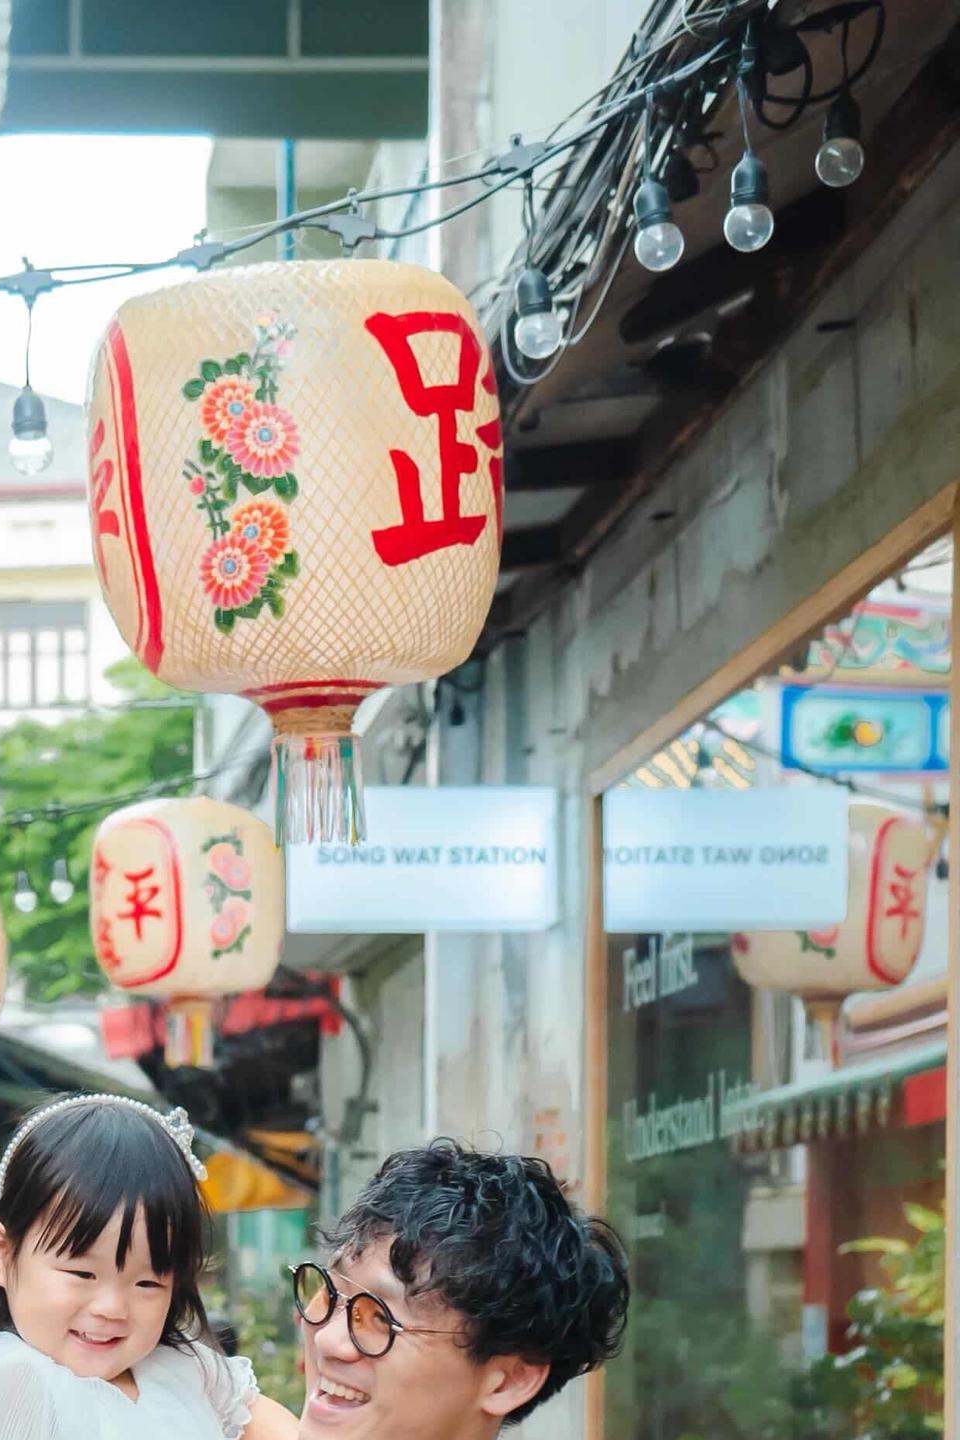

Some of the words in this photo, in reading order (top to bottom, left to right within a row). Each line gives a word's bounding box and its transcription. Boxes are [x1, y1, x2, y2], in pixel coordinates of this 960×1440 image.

[317, 846, 385, 865] SONG
[394, 846, 442, 865] WAT
[448, 846, 547, 865] STATION
[116, 866, 163, 941] 平
[623, 934, 656, 1013] Feel
[623, 1070, 715, 1163] Understand
